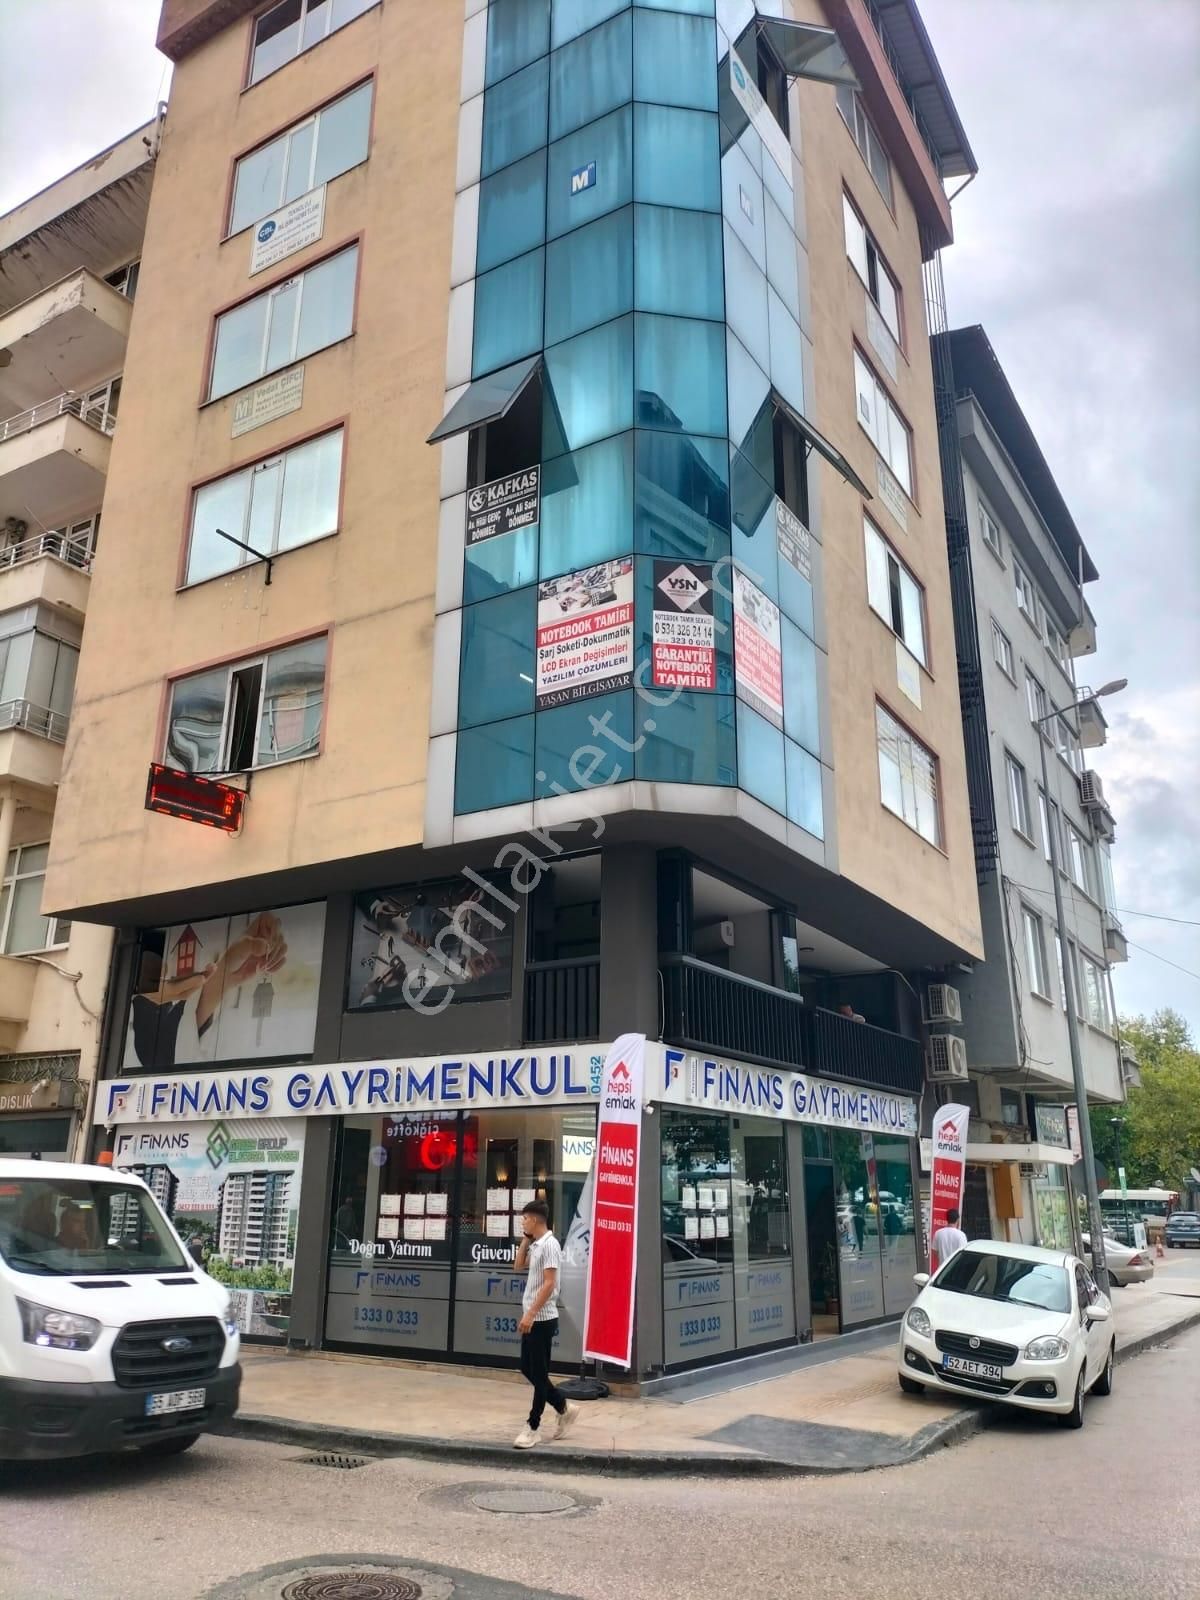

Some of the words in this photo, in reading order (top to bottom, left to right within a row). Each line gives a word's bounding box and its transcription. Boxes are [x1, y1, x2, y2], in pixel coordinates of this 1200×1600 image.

[487, 471, 537, 501] KAFKAS
[515, 502, 524, 513] Ali
[508, 511, 534, 529] DÖNMEZ
[667, 577, 698, 591] YSN
[541, 618, 592, 645] NOTEBOOK
[594, 606, 631, 630] TAMİRİ
[655, 614, 679, 622] NOTEBOOK
[655, 624, 660, 634] 0
[661, 624, 675, 636] 534
[677, 625, 690, 637] 326
[692, 626, 702, 638] 24
[704, 627, 712, 639] 14
[655, 647, 713, 664] GARANTİLİ
[541, 660, 557, 674] LCD
[559, 655, 582, 670] Ekran
[656, 660, 712, 675] NOTEBOOK
[572, 674, 631, 698] BİLGİSAYAR
[657, 673, 711, 688] TAMİRİ
[287, 1055, 587, 1108] GAYRİMENKUL
[607, 1079, 632, 1096] hepsi
[605, 1096, 636, 1110] emlak
[938, 1129, 961, 1143] hepsi
[600, 1142, 634, 1167] FİNANS
[937, 1142, 962, 1154] emlak
[935, 1170, 960, 1188] FİNANS
[349, 1239, 385, 1257] Doğru
[388, 1239, 432, 1260] Yatırım
[361, 1307, 382, 1322] 333
[386, 1309, 393, 1323] 0
[396, 1310, 418, 1325] 333
[948, 1357, 960, 1369] 52
[962, 1360, 980, 1373] AET
[982, 1364, 1000, 1378] 394
